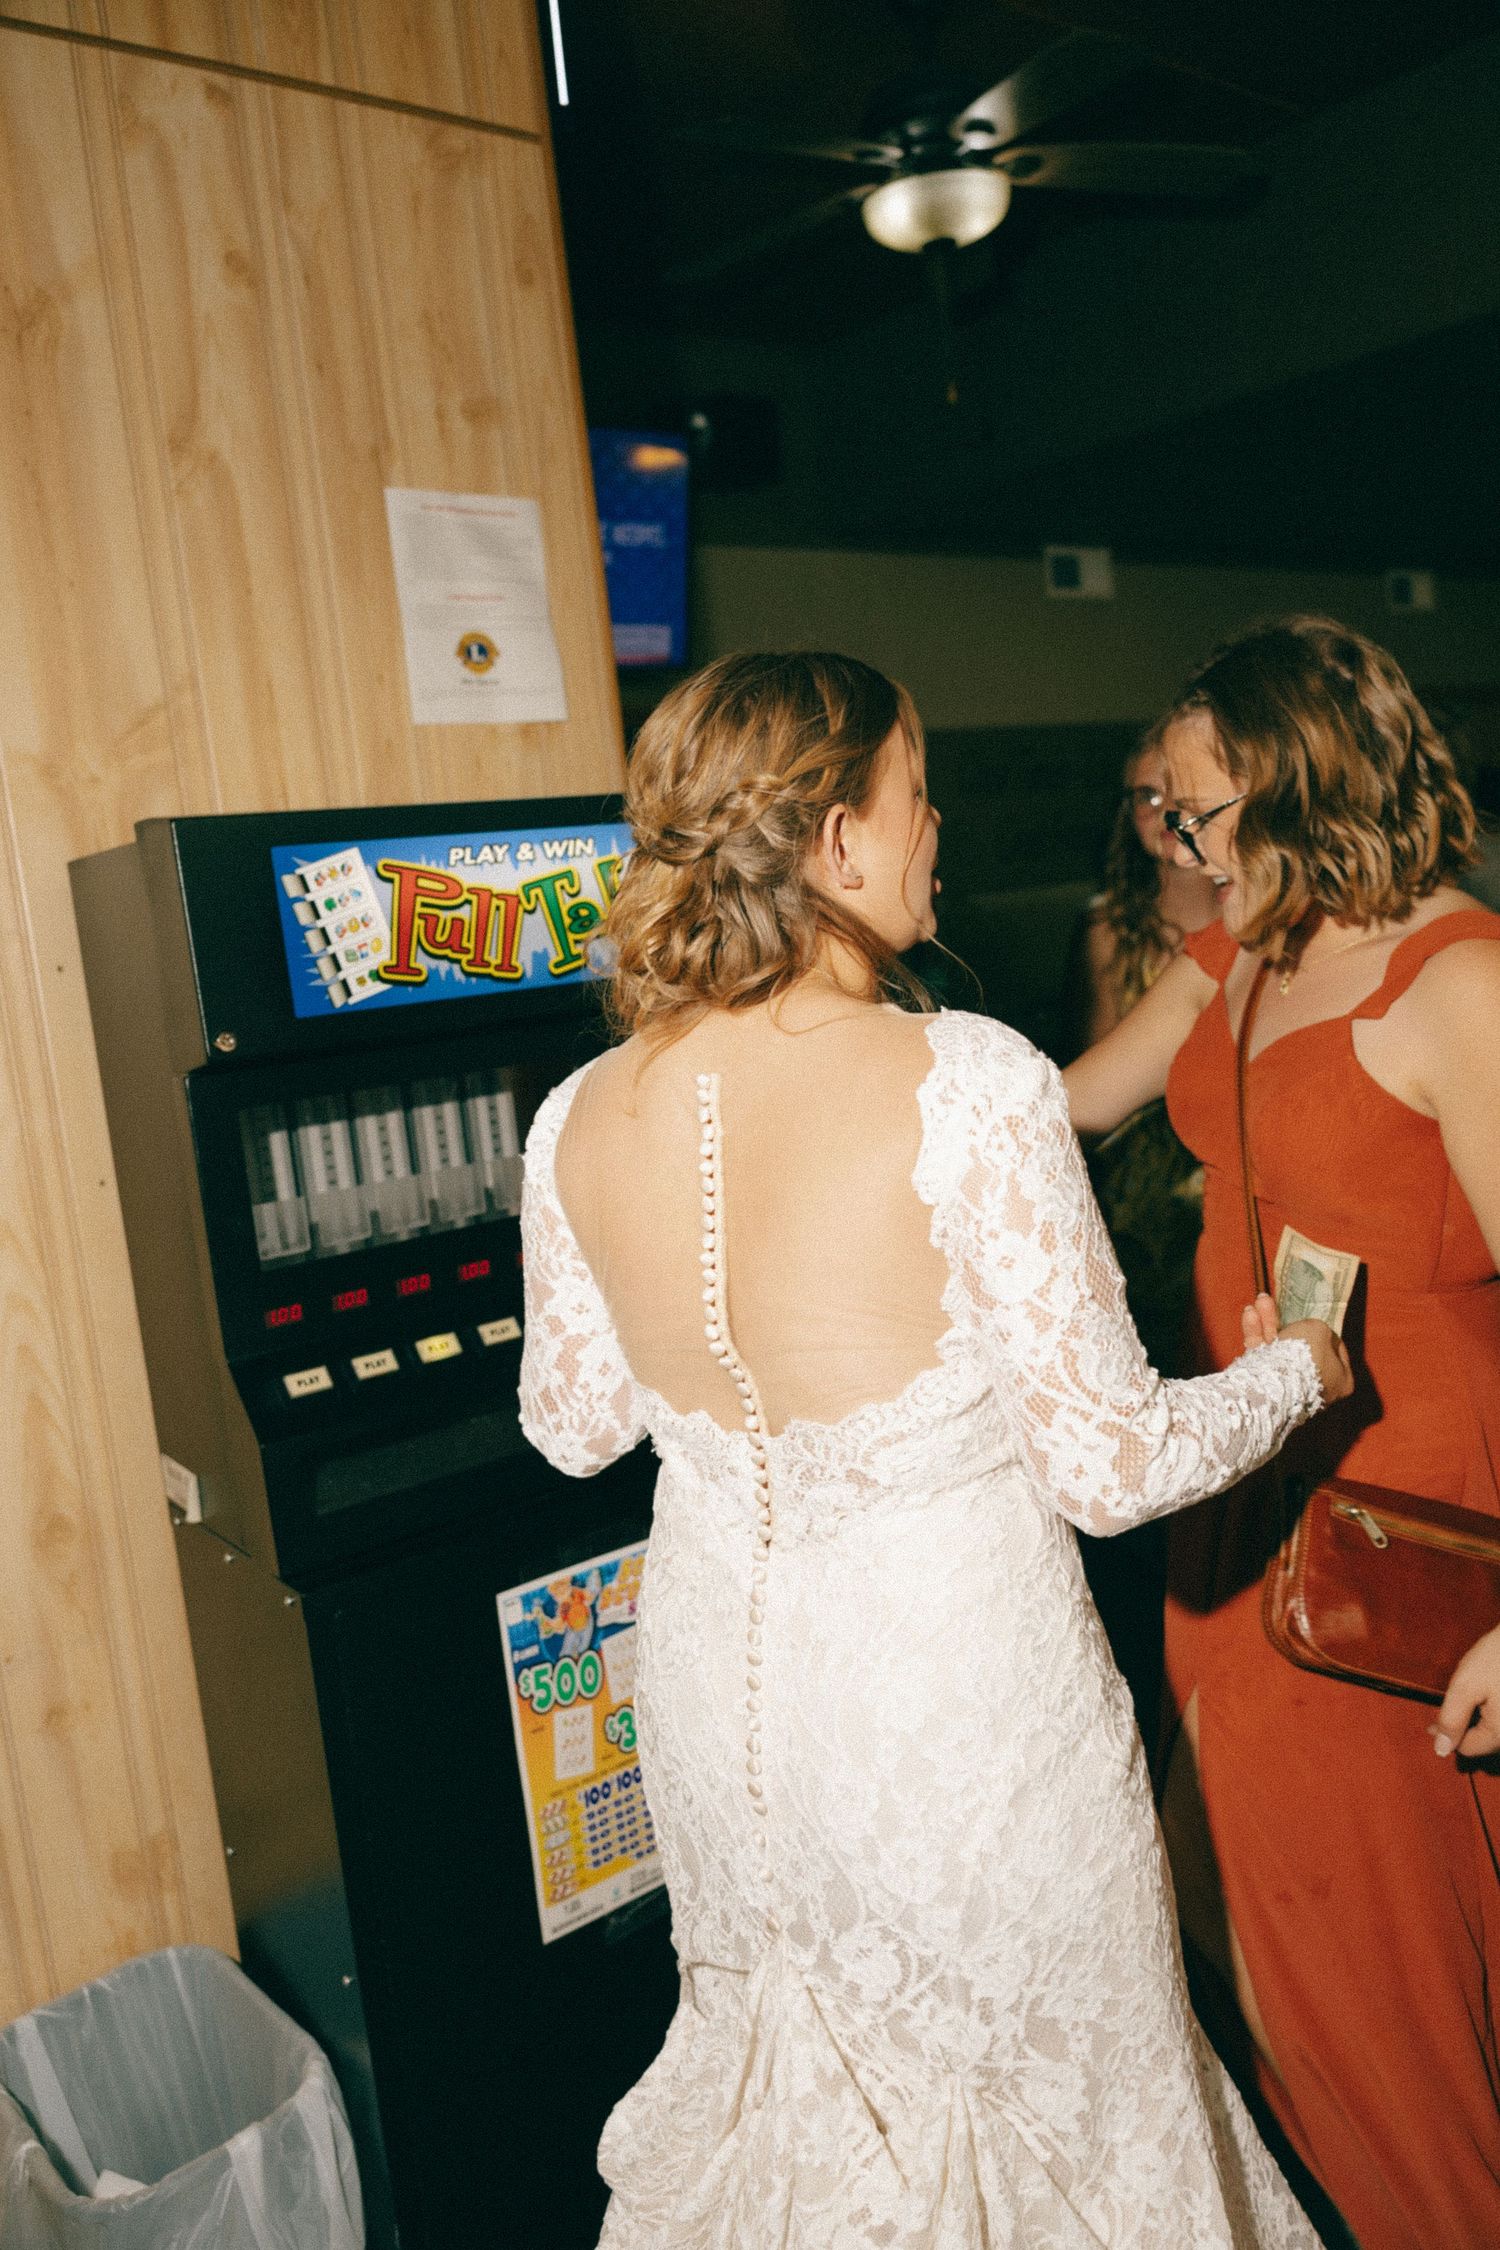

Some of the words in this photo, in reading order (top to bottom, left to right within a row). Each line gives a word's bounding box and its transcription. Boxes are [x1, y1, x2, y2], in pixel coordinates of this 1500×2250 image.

[449, 844, 510, 866] PLAY
[515, 841, 535, 861] &
[542, 838, 594, 860] WIN
[377, 858, 524, 983] Pull
[364, 1359, 387, 1370] PLAY
[297, 1376, 320, 1387] PLAY
[518, 1649, 603, 1714] $500
